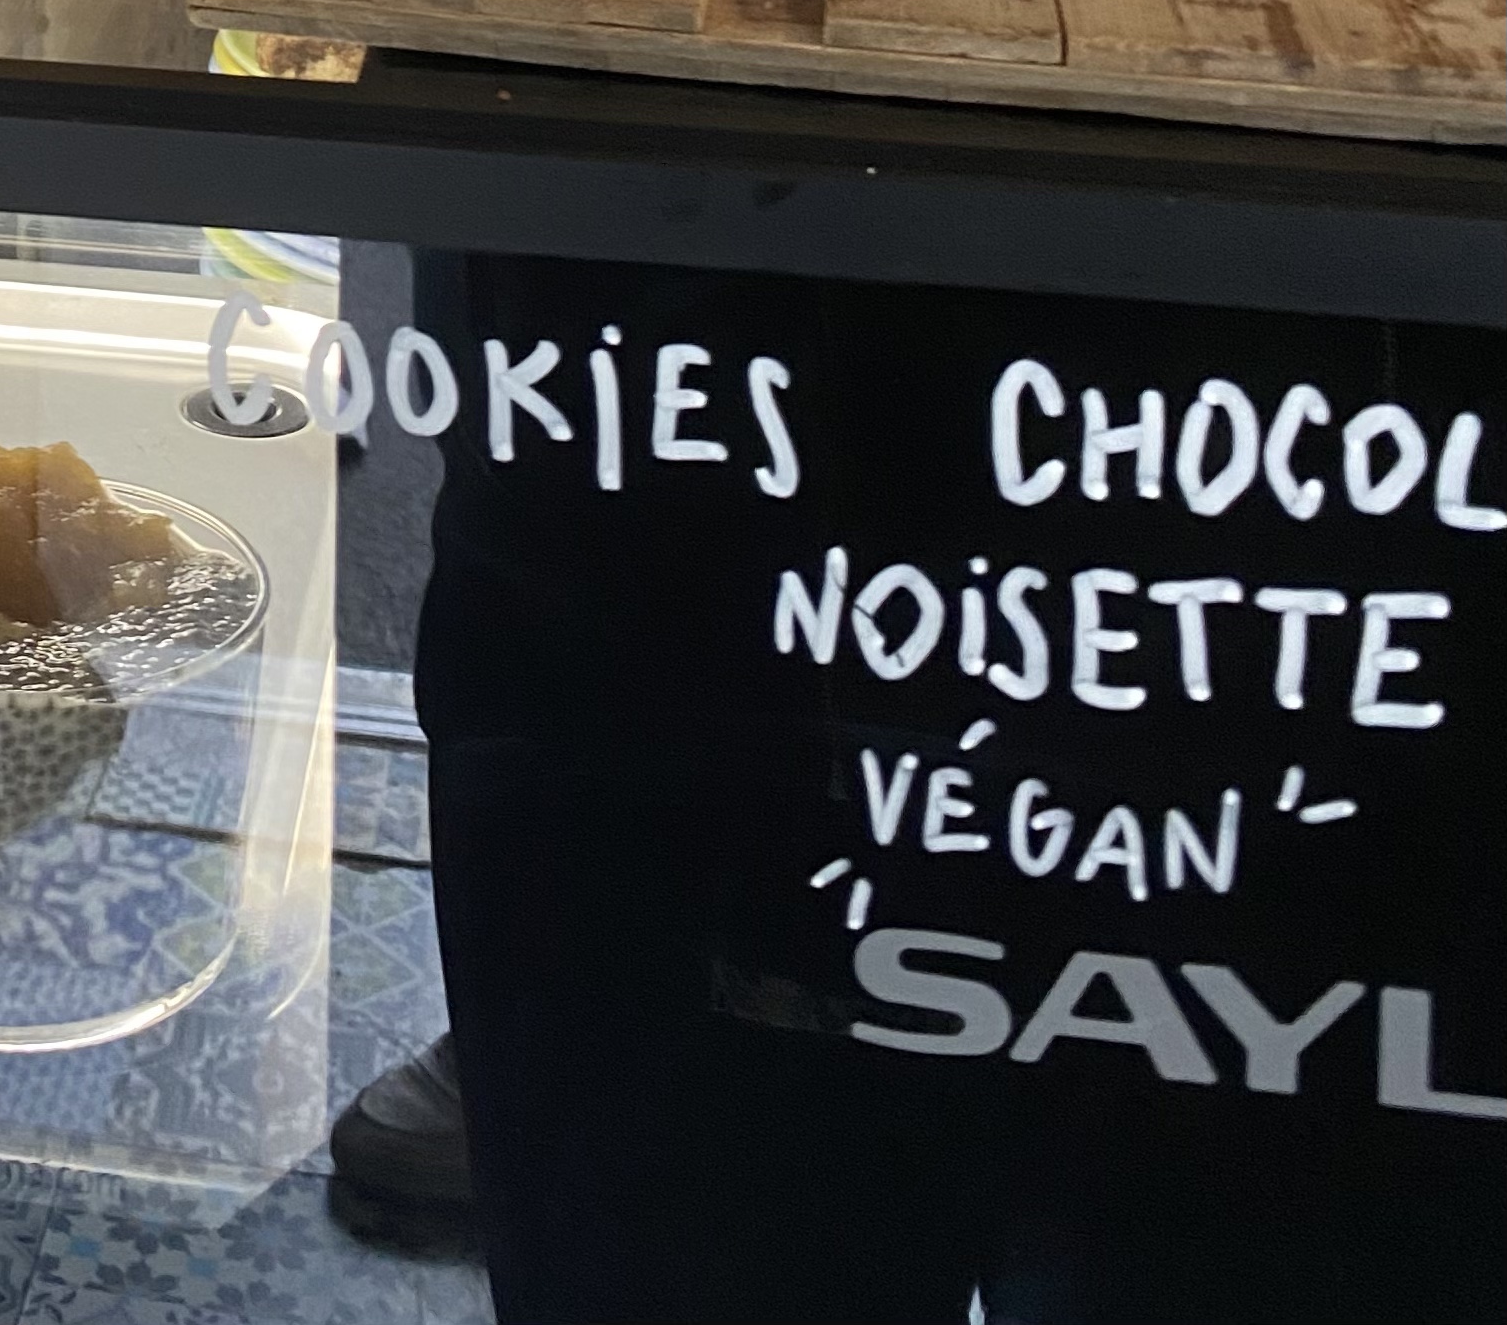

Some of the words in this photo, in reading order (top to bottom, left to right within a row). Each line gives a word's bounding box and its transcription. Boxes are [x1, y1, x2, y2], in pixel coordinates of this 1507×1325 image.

[207, 290, 800, 498] COOKIES
[992, 358, 1507, 531] CHOCOL
[774, 546, 1451, 729] NOISETTE
[860, 719, 1241, 901] VÉGAN
[852, 927, 1507, 1118] SAYL
